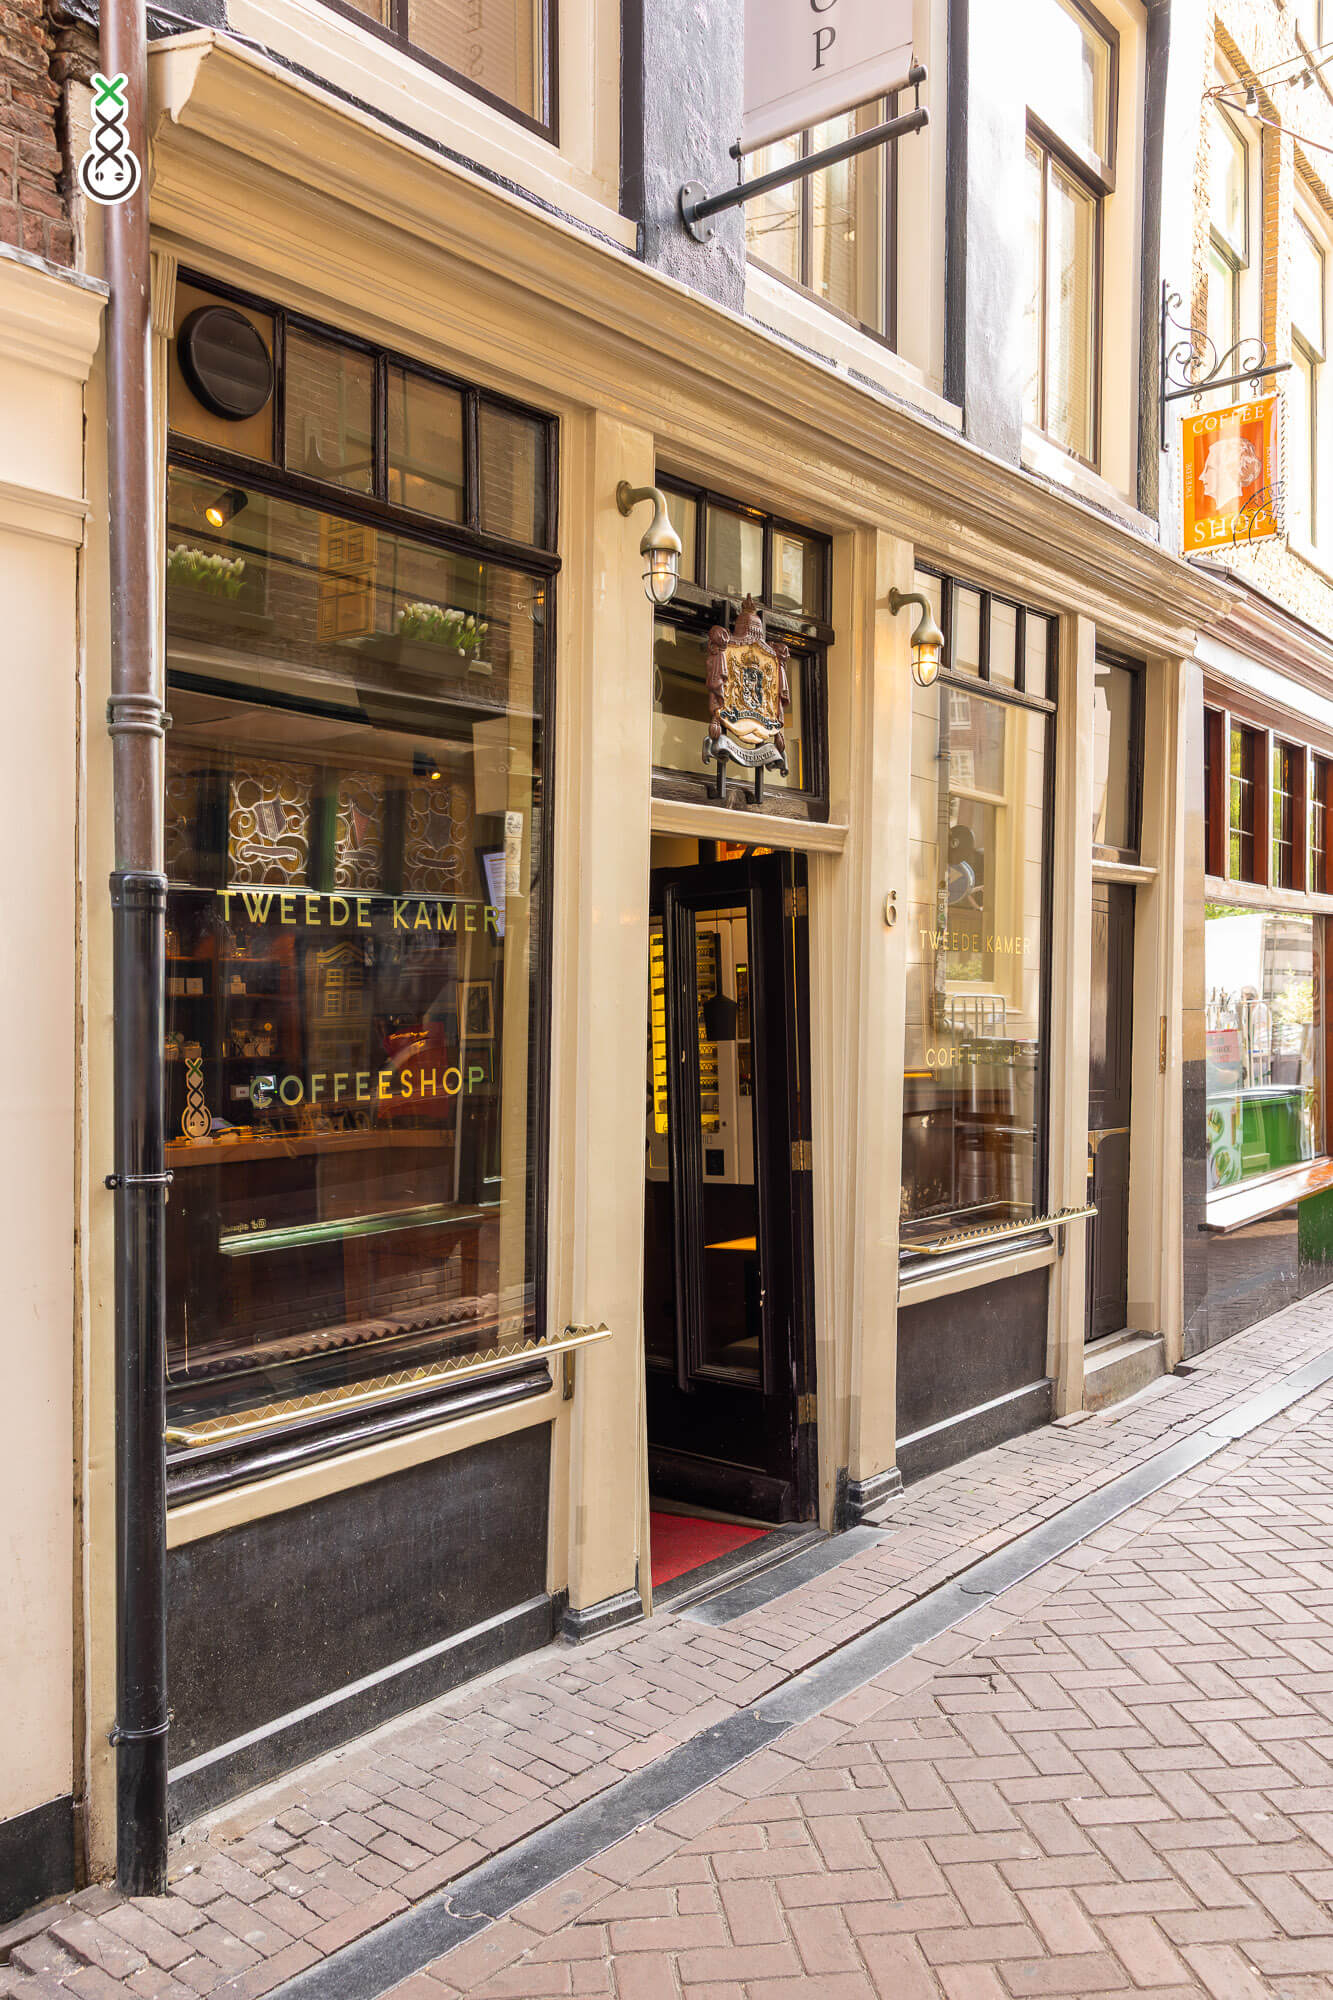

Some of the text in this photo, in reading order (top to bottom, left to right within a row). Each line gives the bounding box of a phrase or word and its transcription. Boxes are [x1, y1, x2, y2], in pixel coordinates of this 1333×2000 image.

[1192, 405, 1265, 434] COFFEE
[1194, 510, 1267, 543] SHOP
[216, 889, 499, 933] TWEEDE KAMER
[884, 888, 897, 927] 6
[920, 930, 1031, 955] TWEEDE KAMER
[250, 1066, 484, 1109] COFFEESHOP
